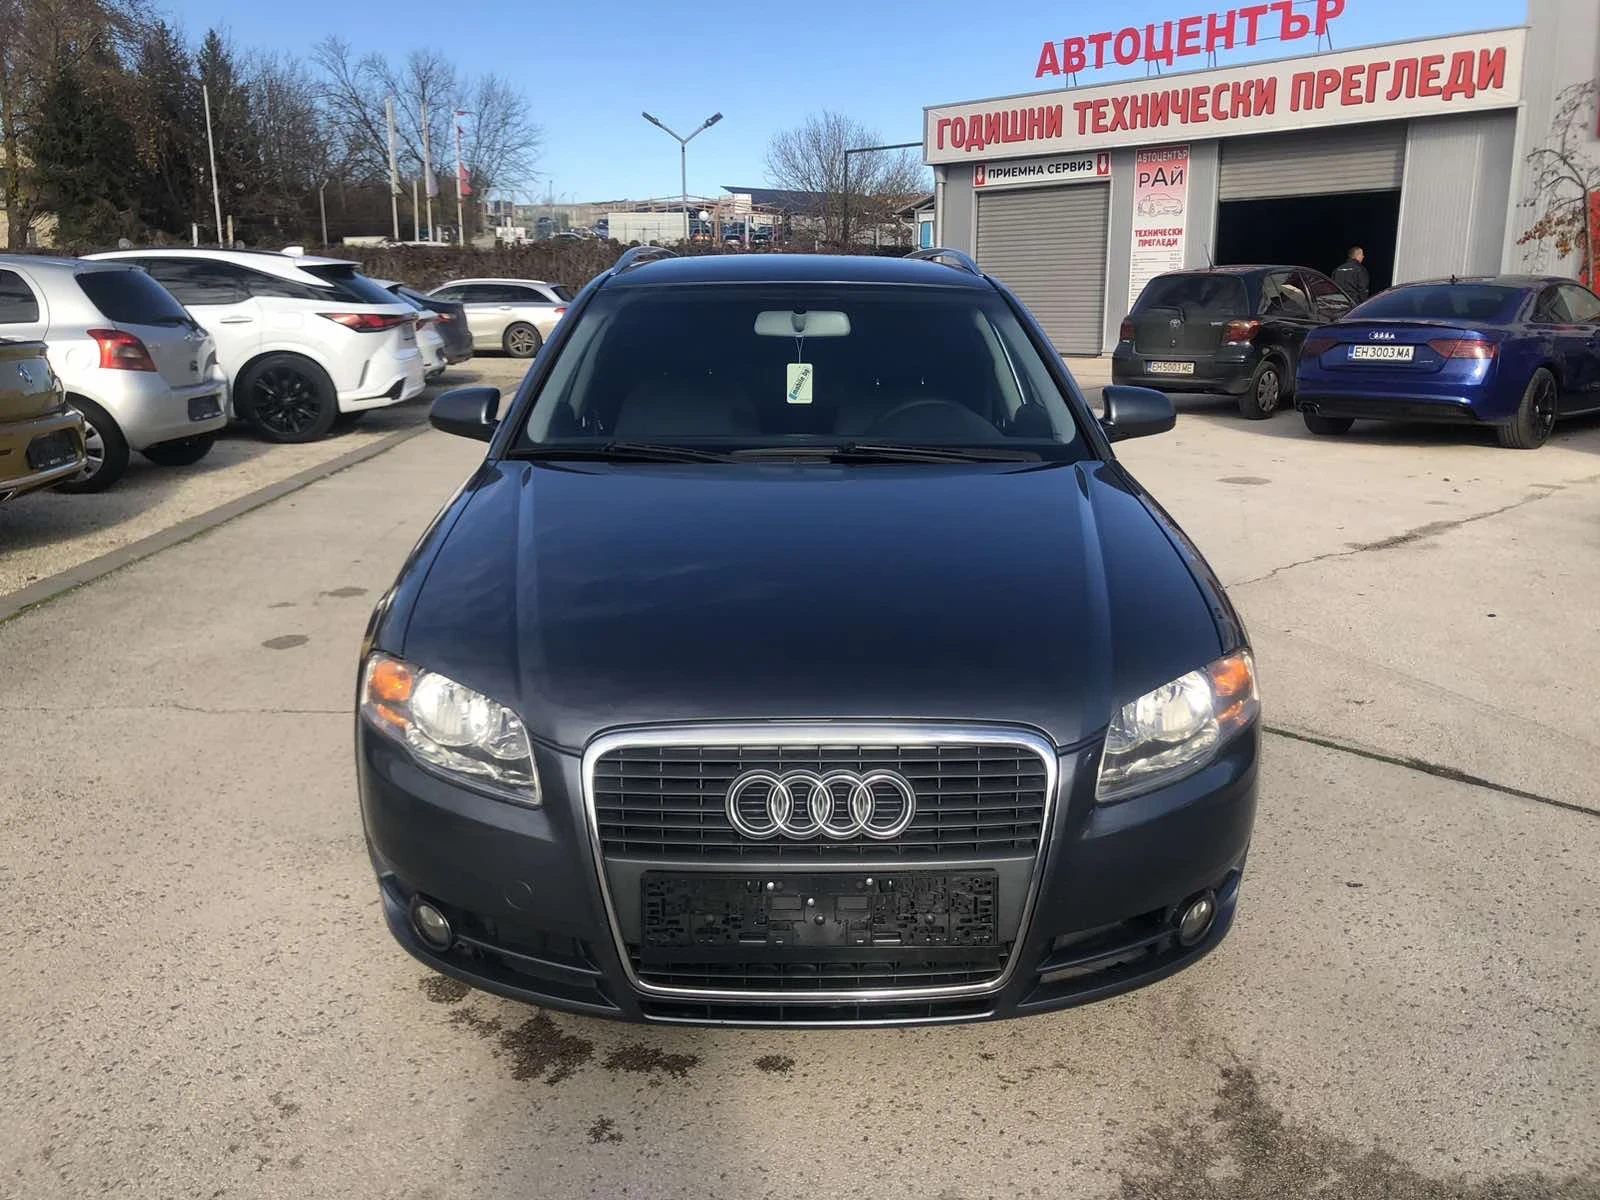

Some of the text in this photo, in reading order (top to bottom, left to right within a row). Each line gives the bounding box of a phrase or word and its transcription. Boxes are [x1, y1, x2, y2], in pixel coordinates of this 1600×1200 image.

[1035, 0, 1345, 78] АВТОЦЕНТЪР
[937, 47, 1506, 152] ГОДИШНИ ТЕХНИЧЕСКИ ПРЕГЛЕДИ
[1137, 150, 1188, 163] АВТОЦЕНТЪР
[988, 160, 1094, 179] ПРИЕМНА СЕРВИЗ
[1135, 228, 1184, 237] ТЕХНИЧЕСКИ
[1138, 238, 1178, 247] ПРЕГЛЕДИ
